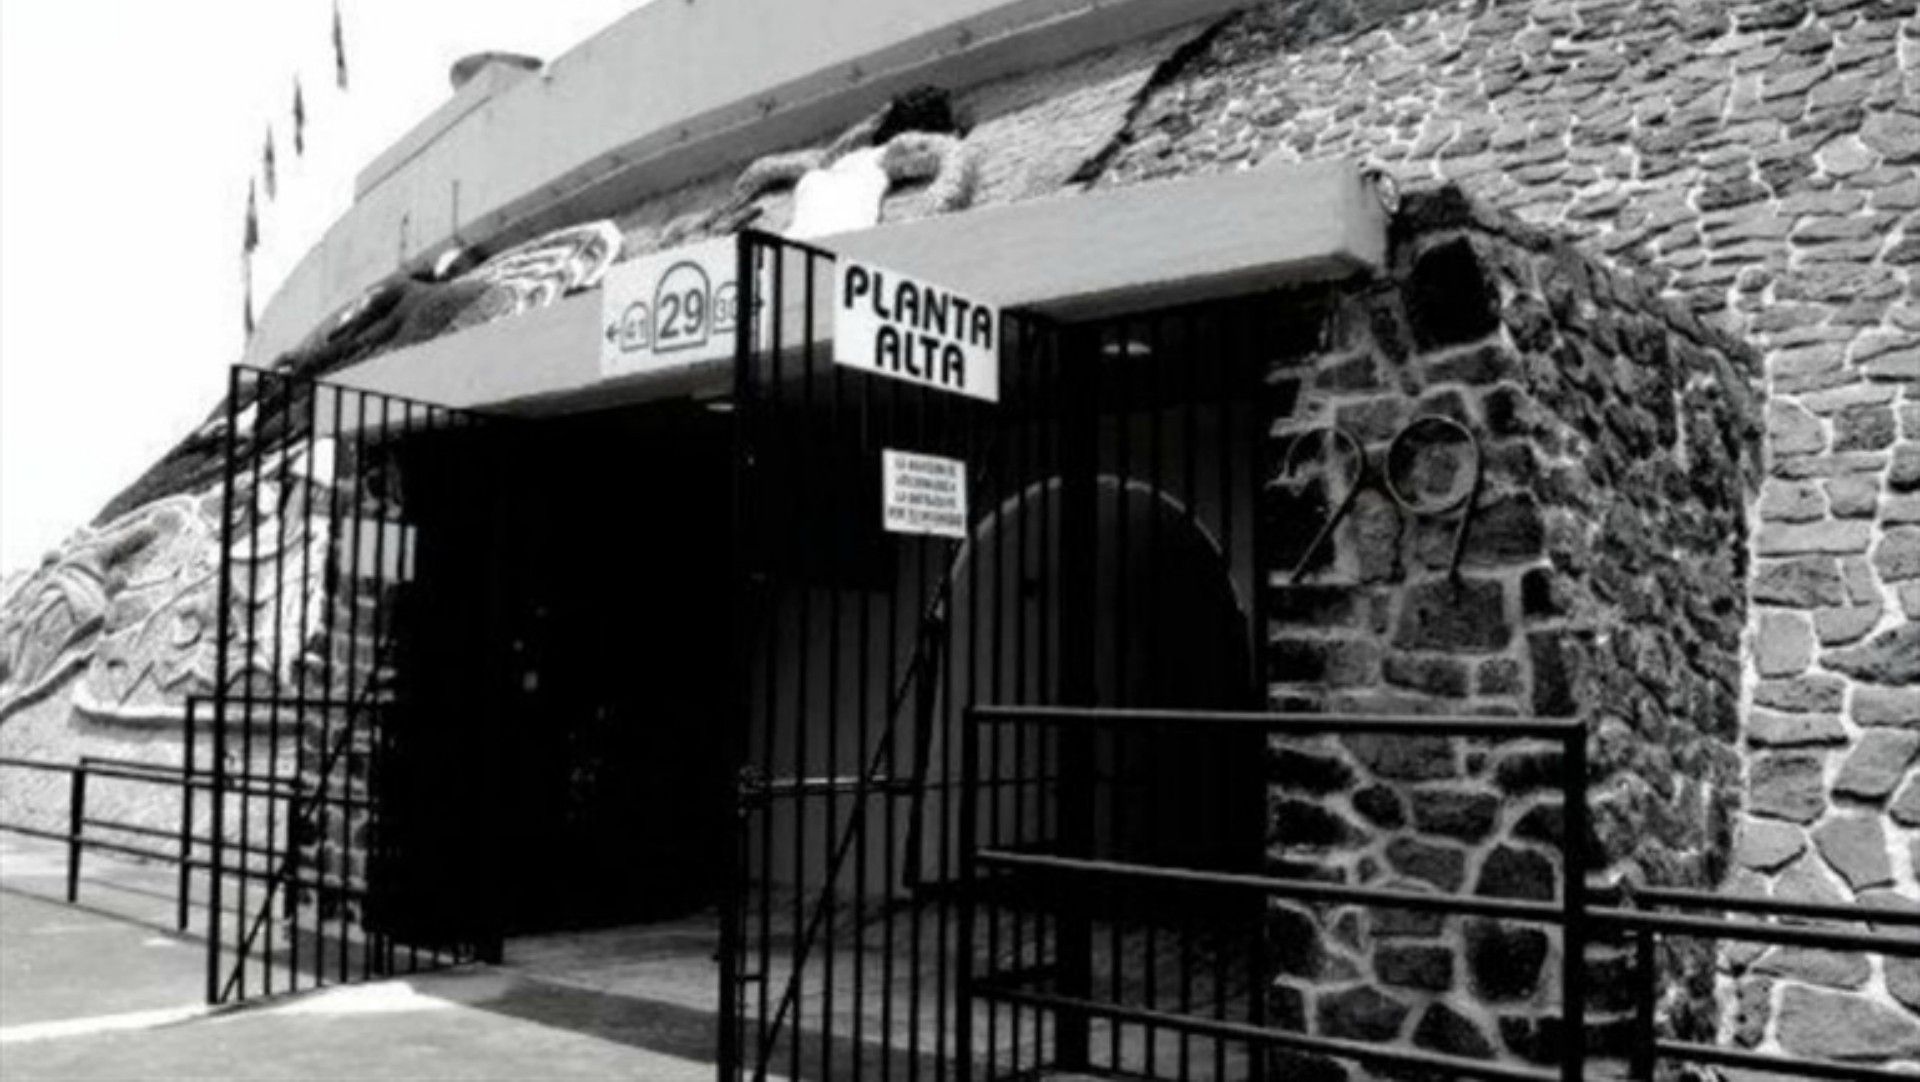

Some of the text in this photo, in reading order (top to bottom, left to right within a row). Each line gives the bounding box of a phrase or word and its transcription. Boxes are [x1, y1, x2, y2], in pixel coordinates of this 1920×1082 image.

[660, 288, 704, 338] 29
[844, 264, 992, 349] PLANTA
[875, 323, 964, 388] ALTA
